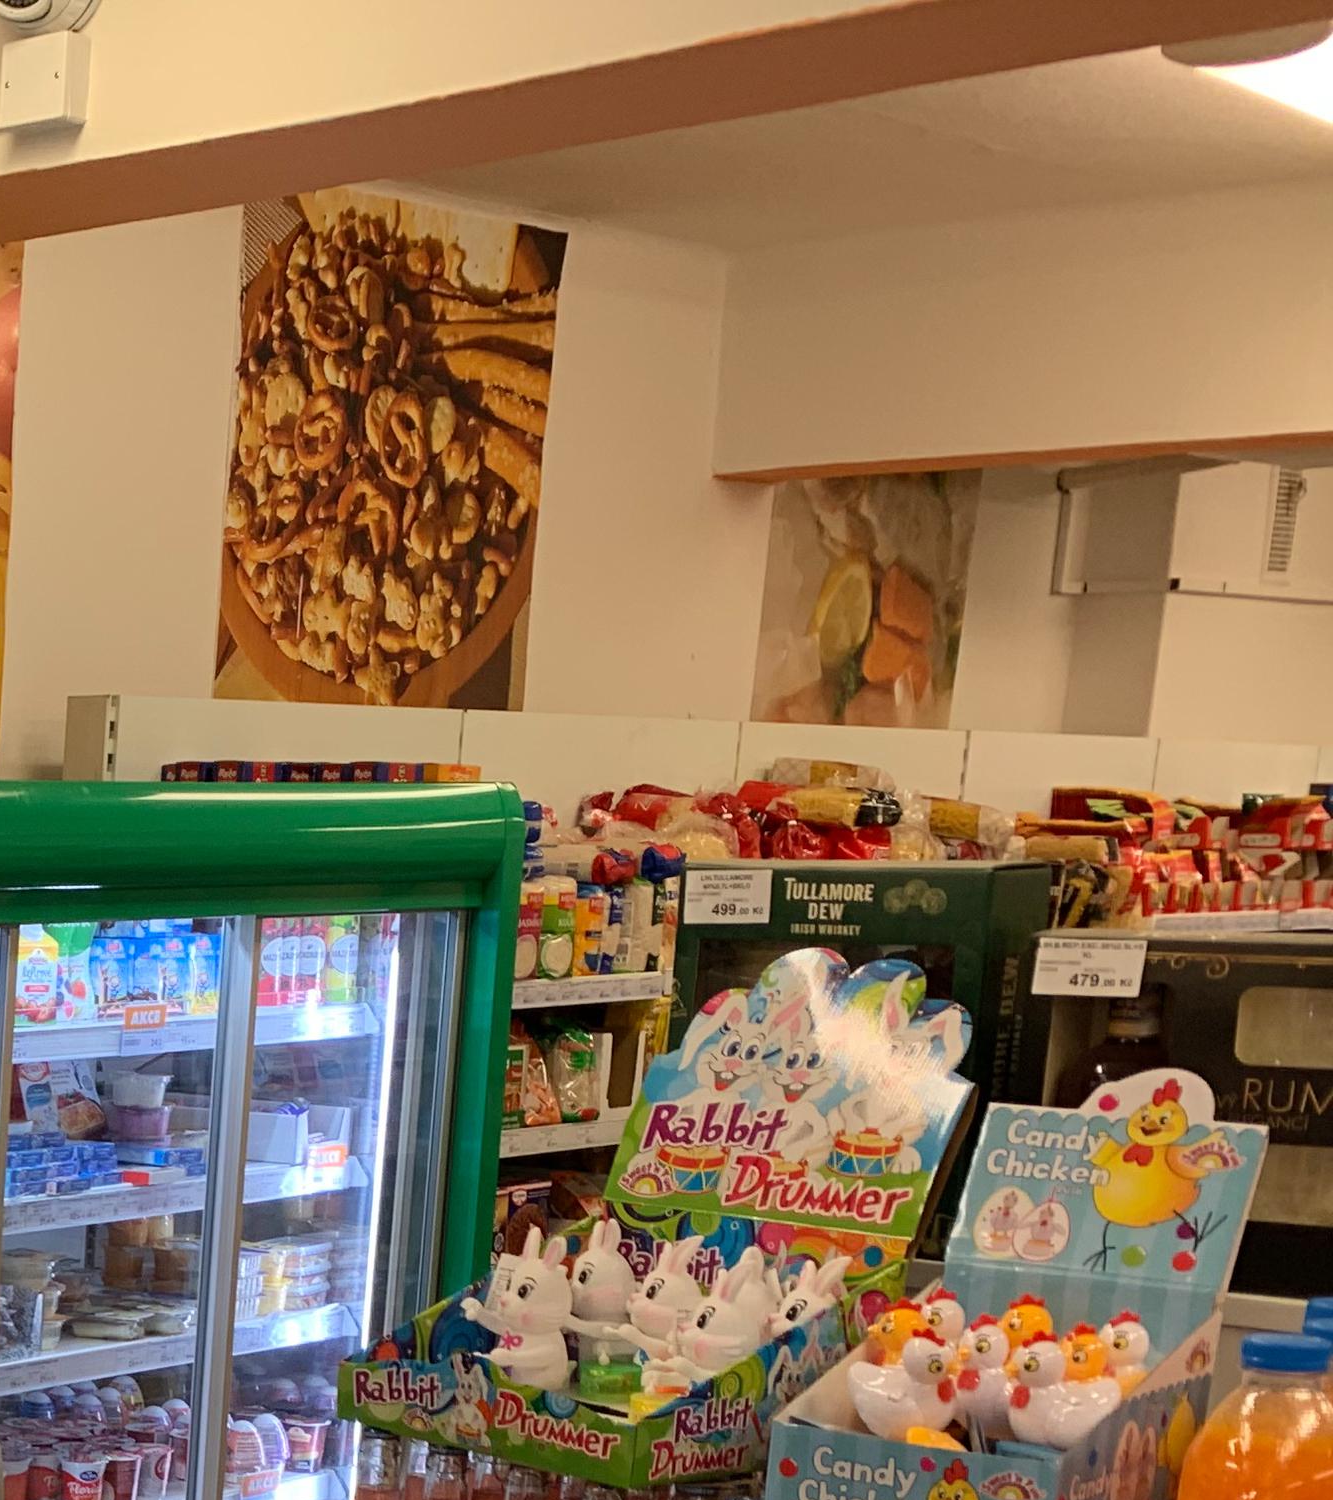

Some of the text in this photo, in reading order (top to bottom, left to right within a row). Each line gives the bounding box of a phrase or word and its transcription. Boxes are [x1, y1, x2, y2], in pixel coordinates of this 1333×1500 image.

[784, 877, 875, 903] TULLAMORE
[790, 923, 862, 936] IRISH WHISKEY
[808, 902, 845, 921] DEW
[644, 1104, 790, 1151] Rabbit
[1007, 1117, 1105, 1160] Candy
[986, 1149, 1111, 1187] Chicken
[354, 1370, 441, 1408] Rabbit
[674, 1396, 752, 1443] Rabbit
[813, 1446, 918, 1494] Candy
